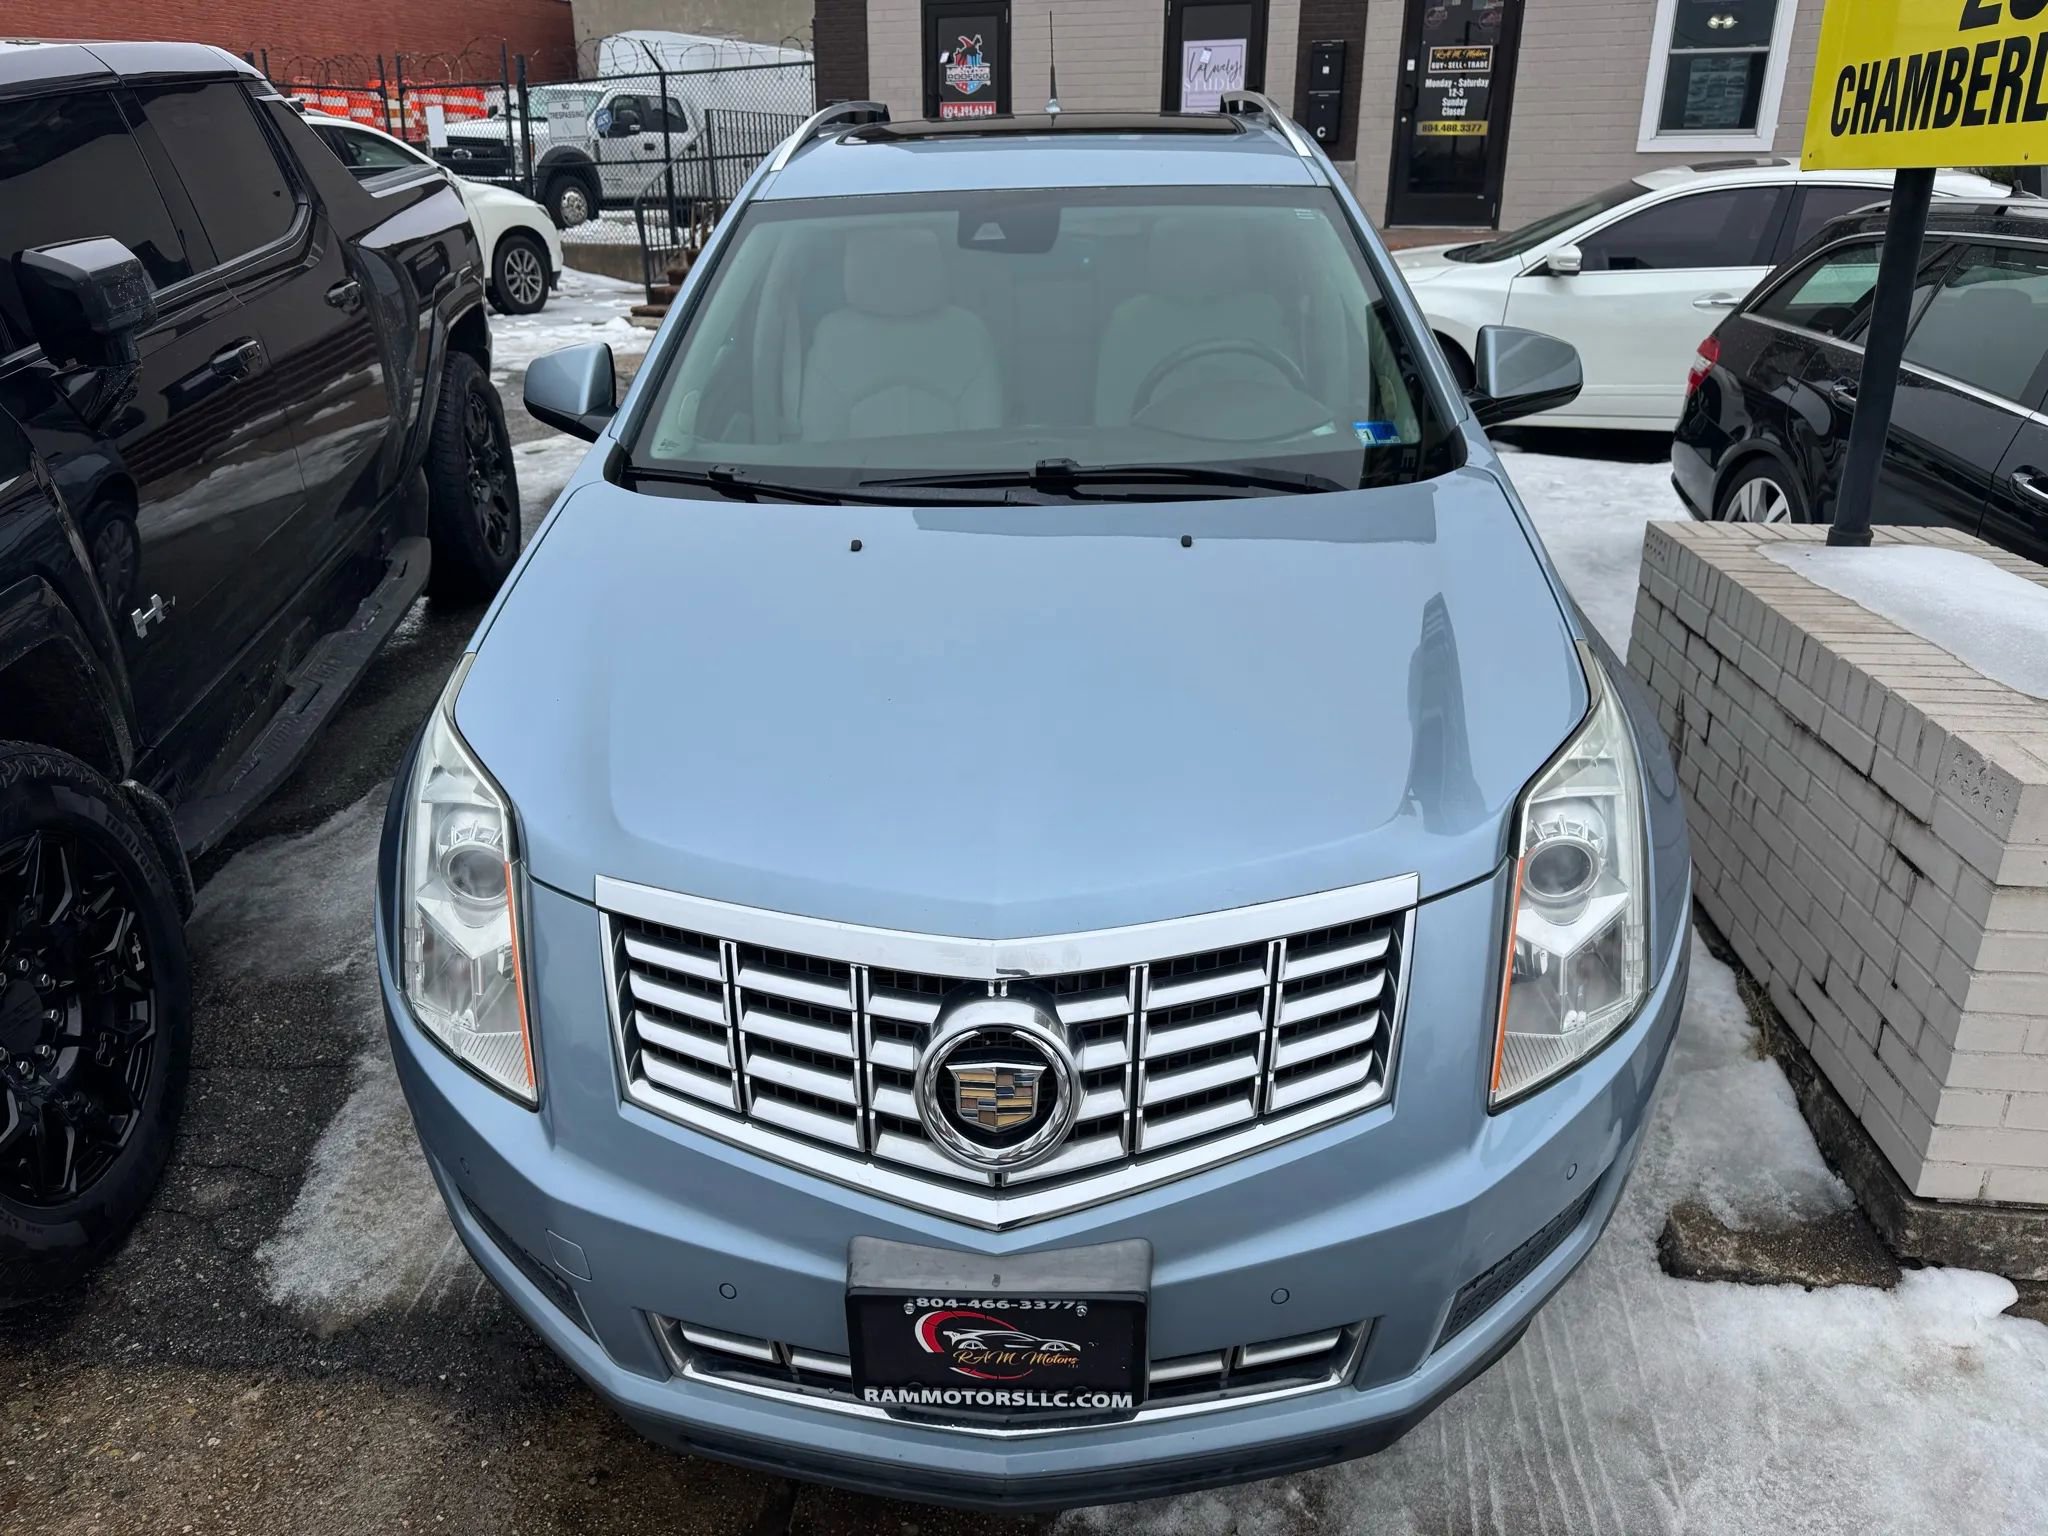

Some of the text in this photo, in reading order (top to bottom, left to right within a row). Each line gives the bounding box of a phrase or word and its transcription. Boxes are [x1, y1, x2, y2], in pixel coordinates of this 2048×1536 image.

[1448, 61, 1463, 69] SELL
[948, 72, 989, 80] ROOFING
[1184, 78, 1244, 91] STUDIO
[1425, 78, 1489, 88] Monday Saturday
[1442, 97, 1468, 107] Sunday
[1441, 107, 1465, 116] Closed
[1316, 126, 1326, 138] C
[916, 1298, 1076, 1310] 804-466-3377
[953, 1350, 1080, 1366] RAM Motors
[864, 1388, 1133, 1409] RAMMOTORSLLC.COM
